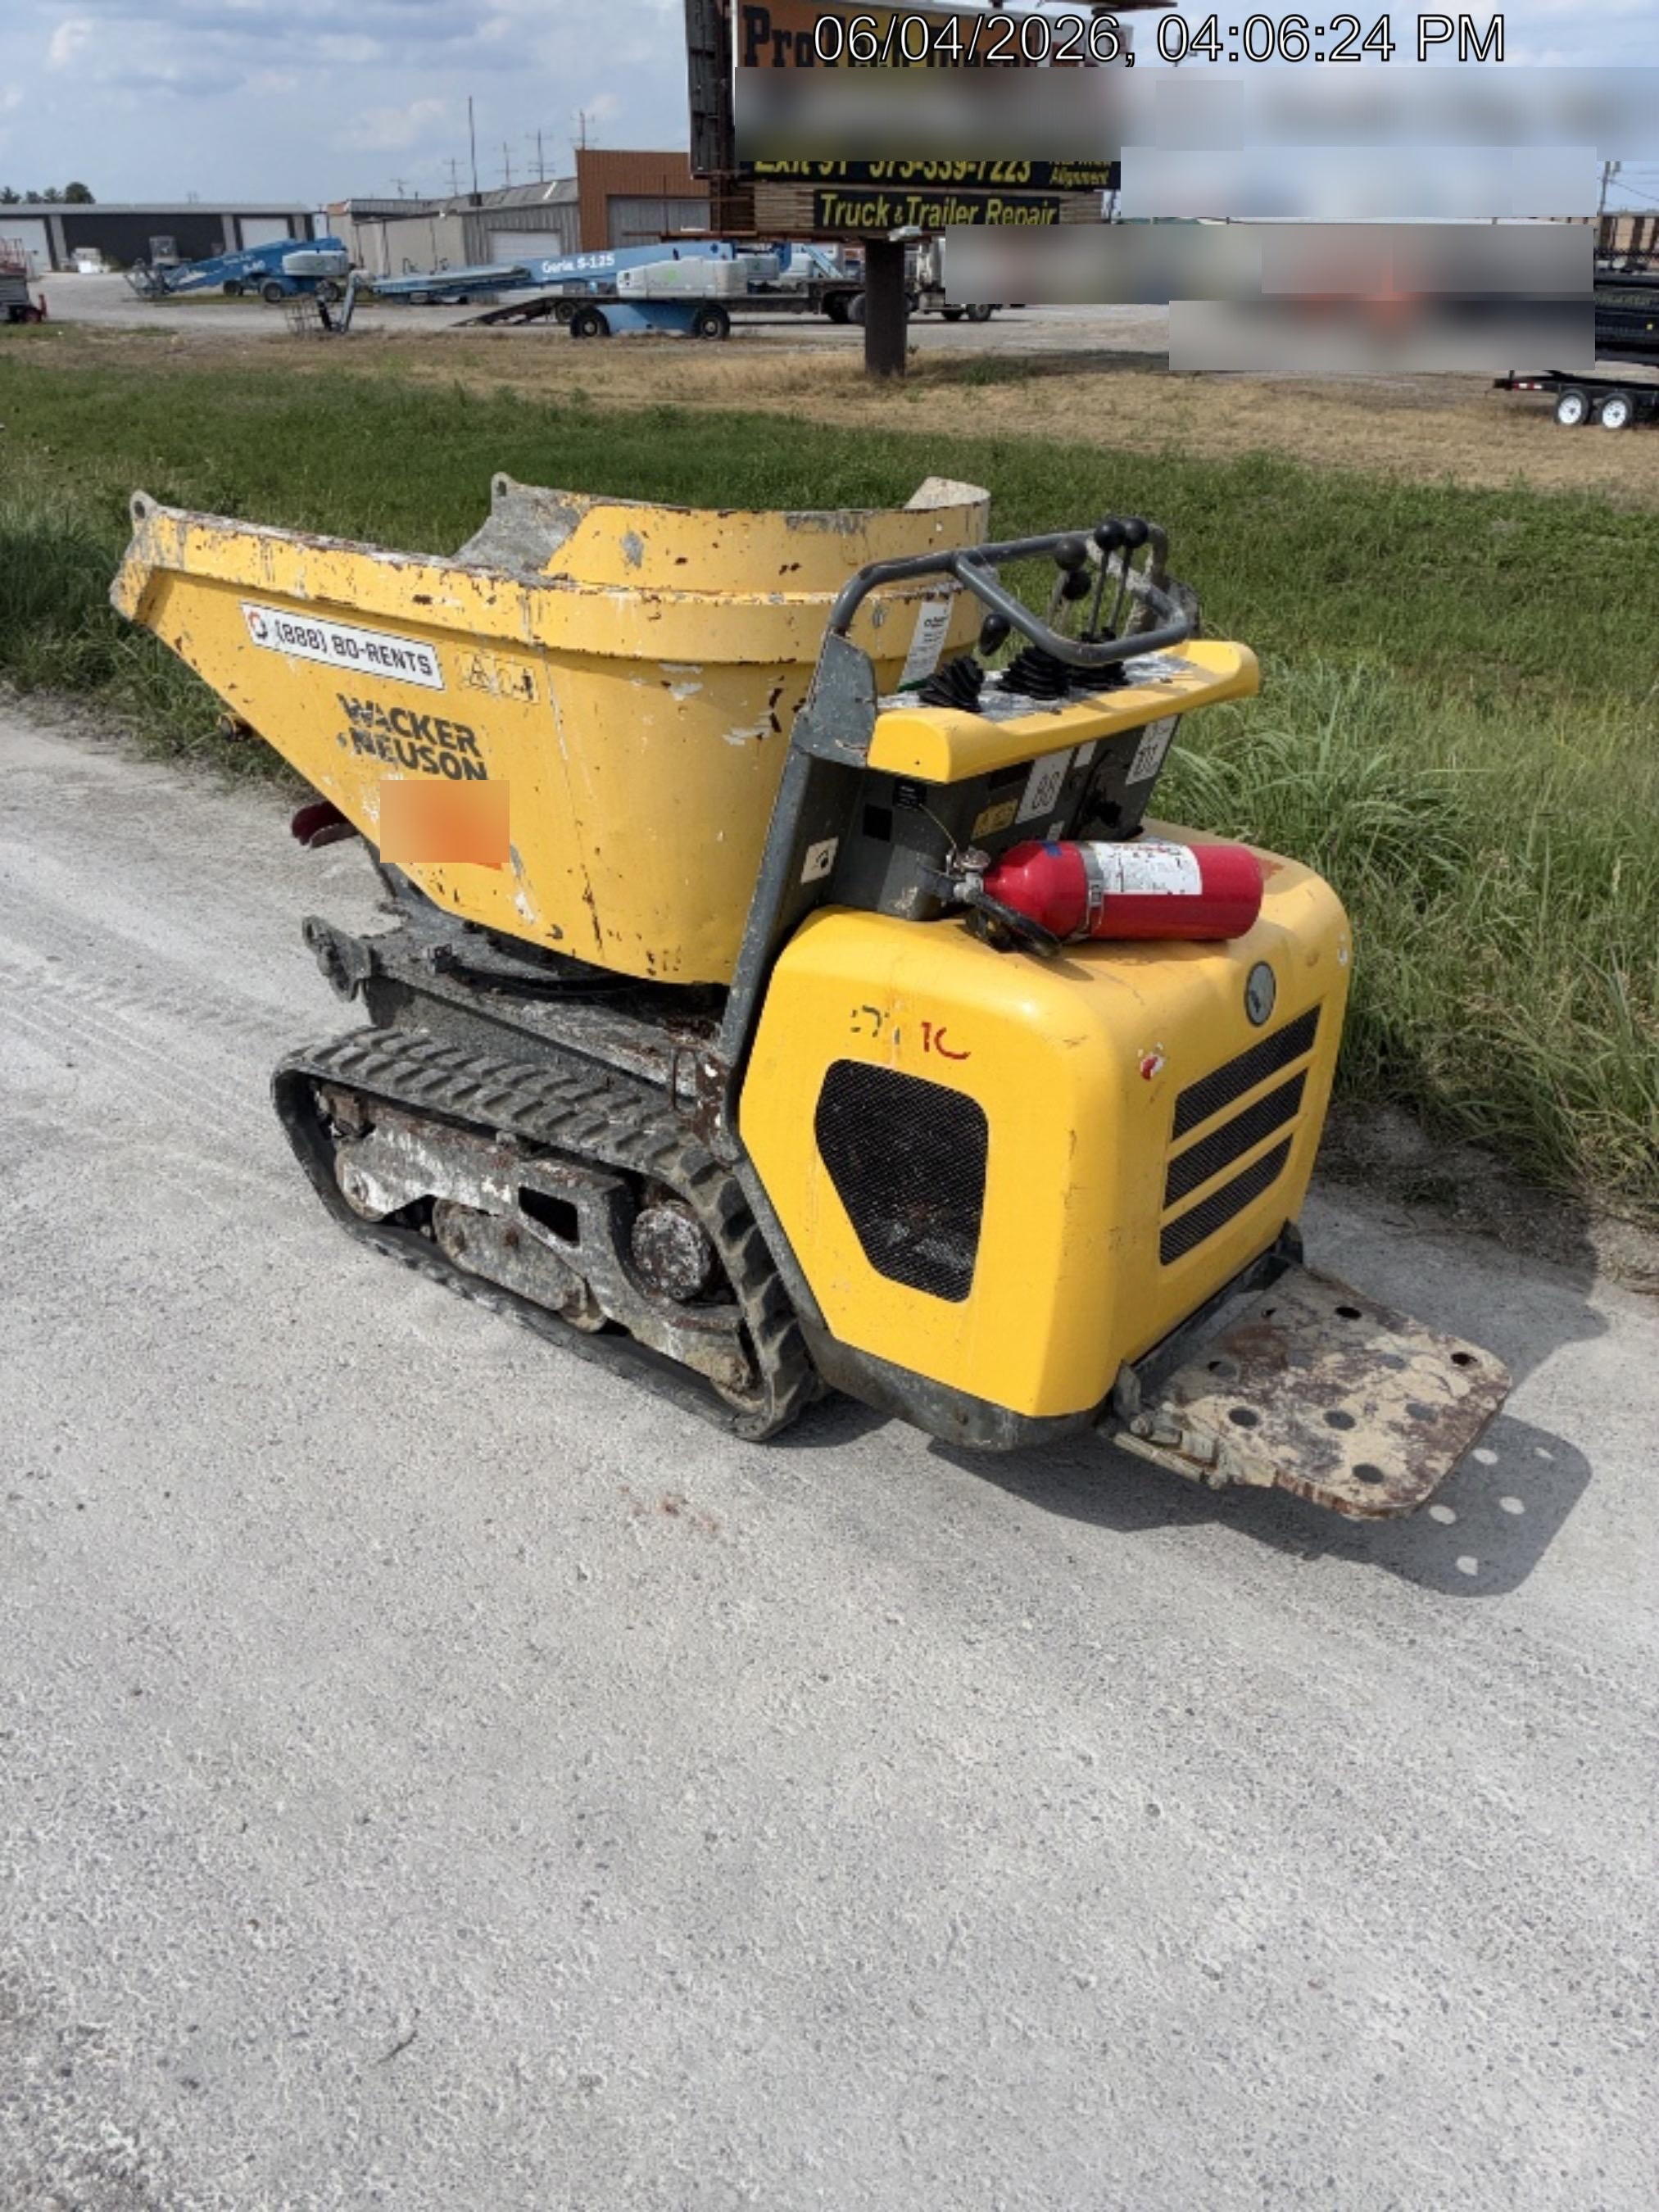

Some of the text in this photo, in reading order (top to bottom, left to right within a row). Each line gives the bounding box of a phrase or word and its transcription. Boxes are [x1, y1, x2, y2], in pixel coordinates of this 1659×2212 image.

[820, 193, 891, 227] Truck
[906, 195, 979, 228] Trailer
[984, 197, 1057, 224] Repair
[274, 619, 328, 654] (888)
[336, 692, 483, 757] WACKER
[348, 727, 489, 780] NEUSON
